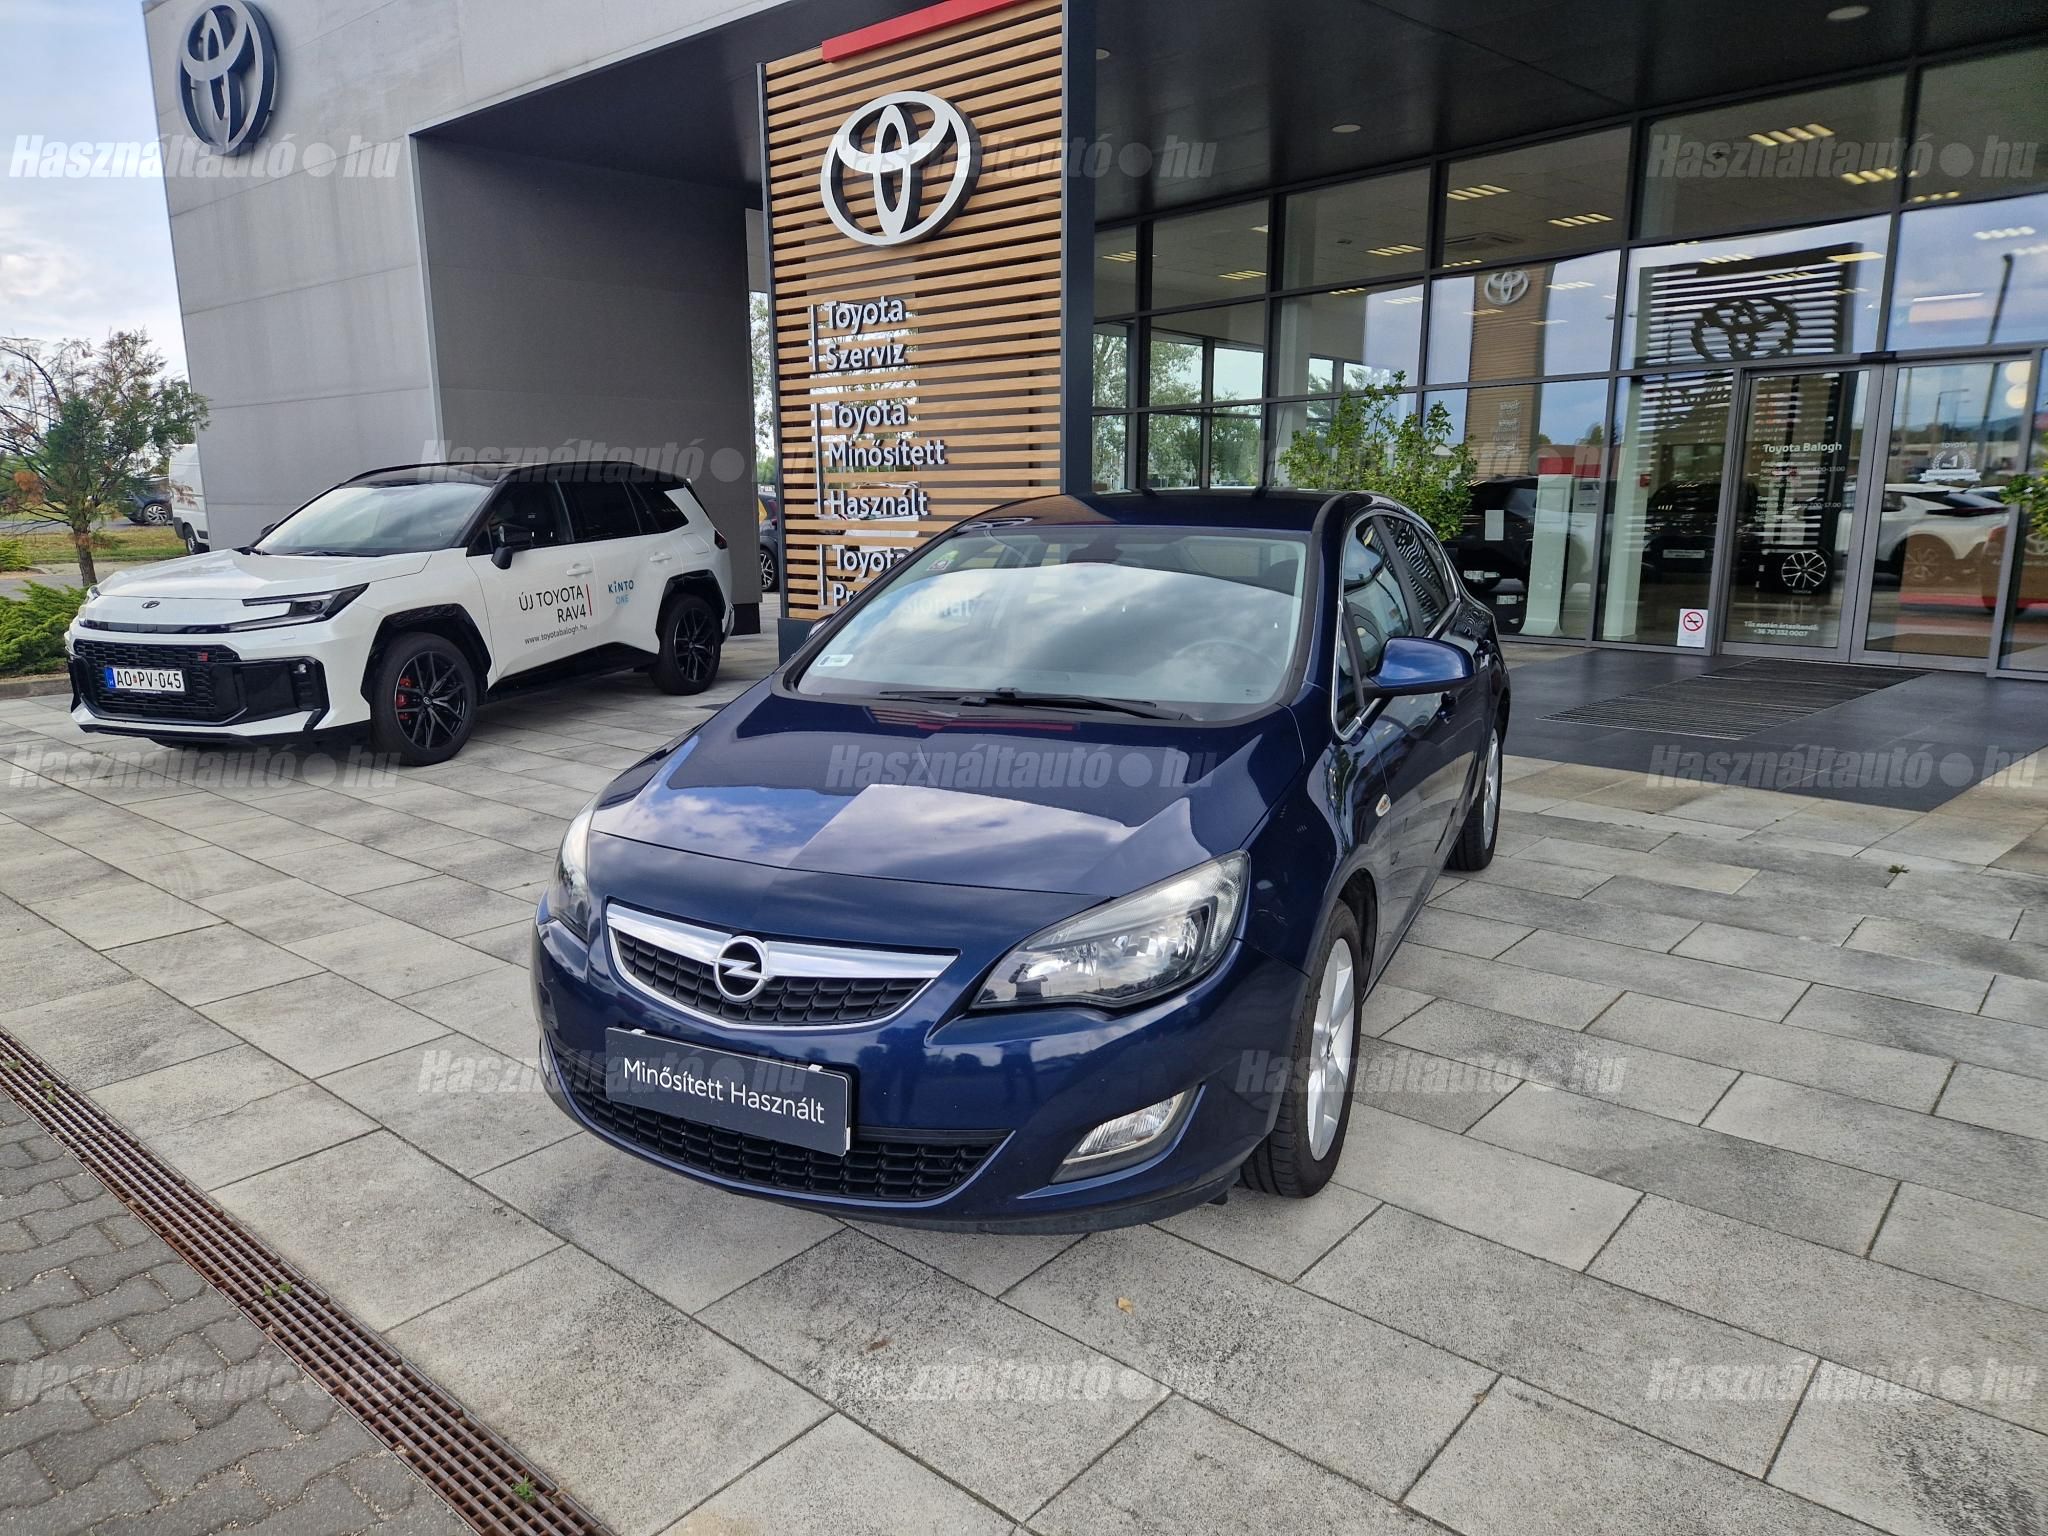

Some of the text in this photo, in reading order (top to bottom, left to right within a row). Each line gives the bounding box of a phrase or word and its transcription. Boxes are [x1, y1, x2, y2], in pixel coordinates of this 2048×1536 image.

[824, 296, 905, 334] Toyota
[826, 338, 907, 370] Szerviz
[829, 399, 908, 435] Toyota
[828, 440, 947, 467] Minősített
[1762, 441, 1842, 454] Toyota Balogh
[829, 489, 929, 516] Használt
[519, 585, 585, 611] ÚJ TOYOTA
[557, 604, 587, 623] RAV4
[524, 624, 588, 645] www.toyotabalogh.hu
[623, 1057, 825, 1124] Minősített Használt
